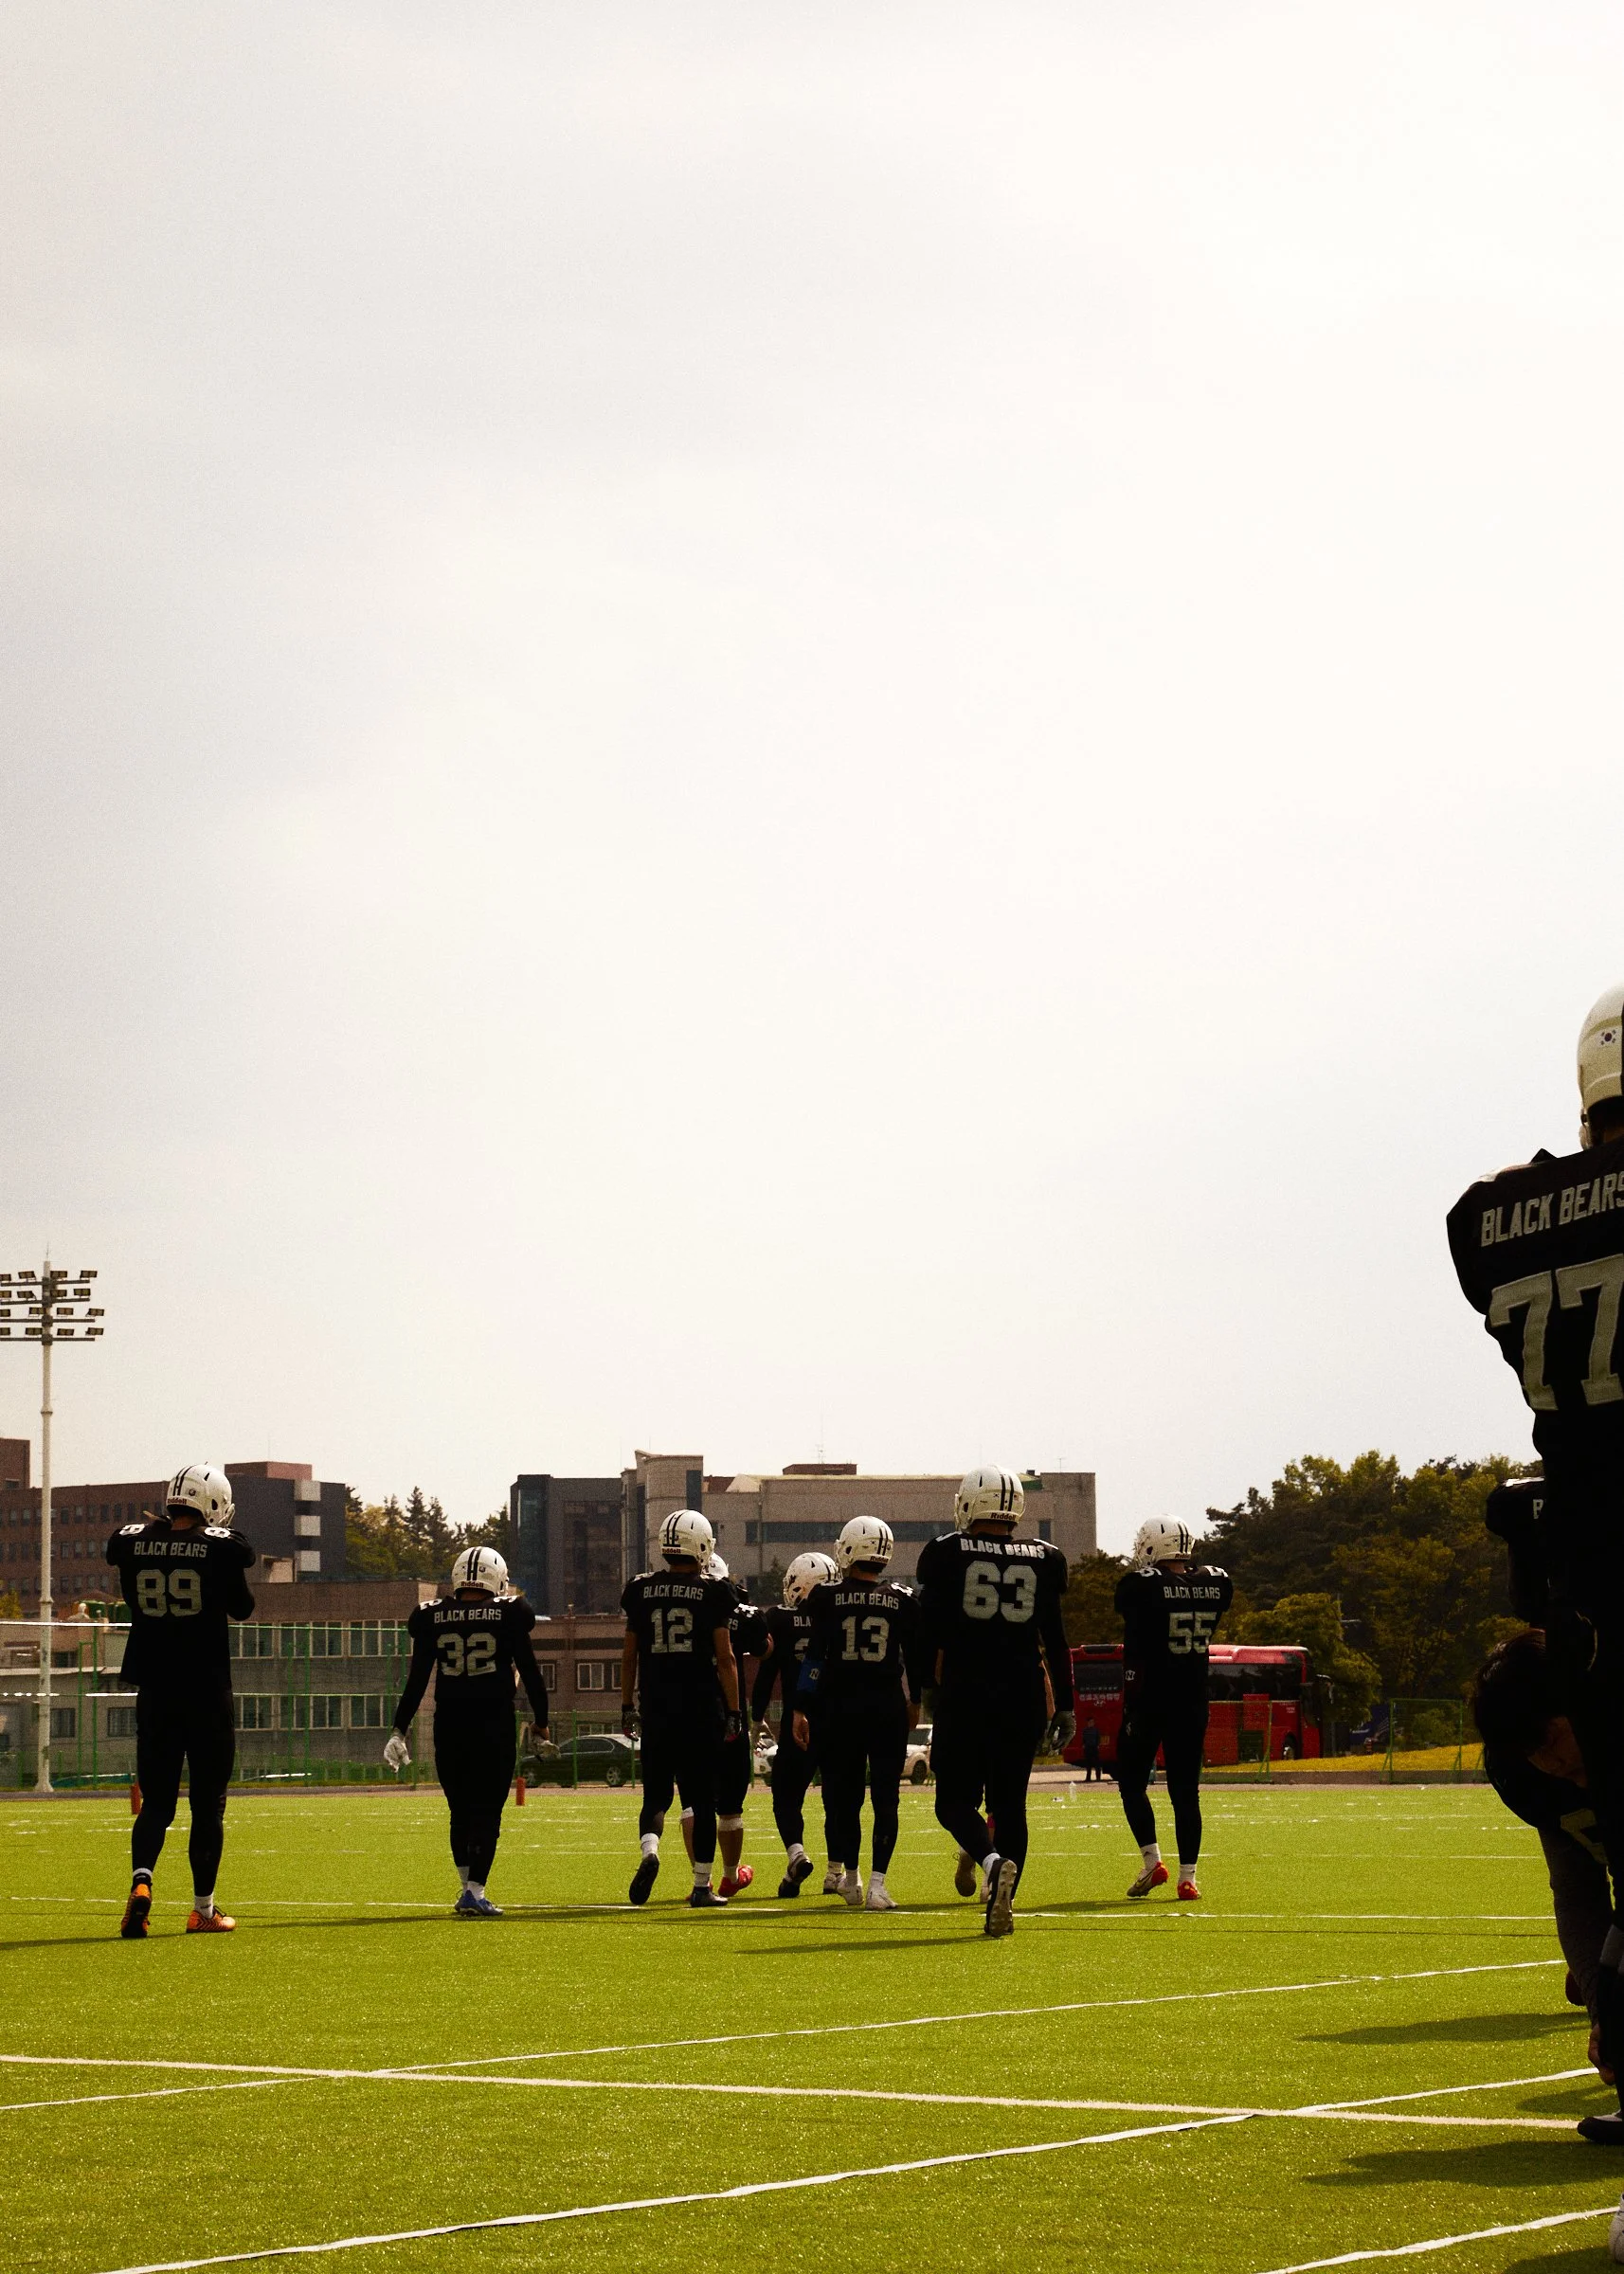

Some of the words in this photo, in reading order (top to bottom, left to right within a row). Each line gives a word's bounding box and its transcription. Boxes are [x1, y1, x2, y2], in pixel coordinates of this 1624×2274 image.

[1480, 1193, 1554, 1247] BLACK
[1488, 1254, 1624, 1410] 77
[134, 1542, 167, 1556] BLACK
[170, 1543, 208, 1558] BEARS
[960, 1538, 1002, 1555] BLACK
[1004, 1543, 1045, 1559] BEARS
[136, 1569, 203, 1617] 89
[643, 1585, 670, 1598] BLACK
[672, 1585, 704, 1601] BEARS
[835, 1593, 866, 1606] BLACK
[868, 1593, 899, 1610] BEARS
[963, 1561, 1037, 1623] 63
[1164, 1586, 1190, 1598] BLACK
[1192, 1587, 1220, 1599] BEARS
[434, 1611, 465, 1624] BLACK
[468, 1609, 502, 1621] BEARS
[651, 1608, 694, 1653] 12
[793, 1615, 812, 1627] BLA
[1167, 1611, 1217, 1654] 55
[437, 1633, 496, 1677] 32
[841, 1615, 890, 1663] 13
